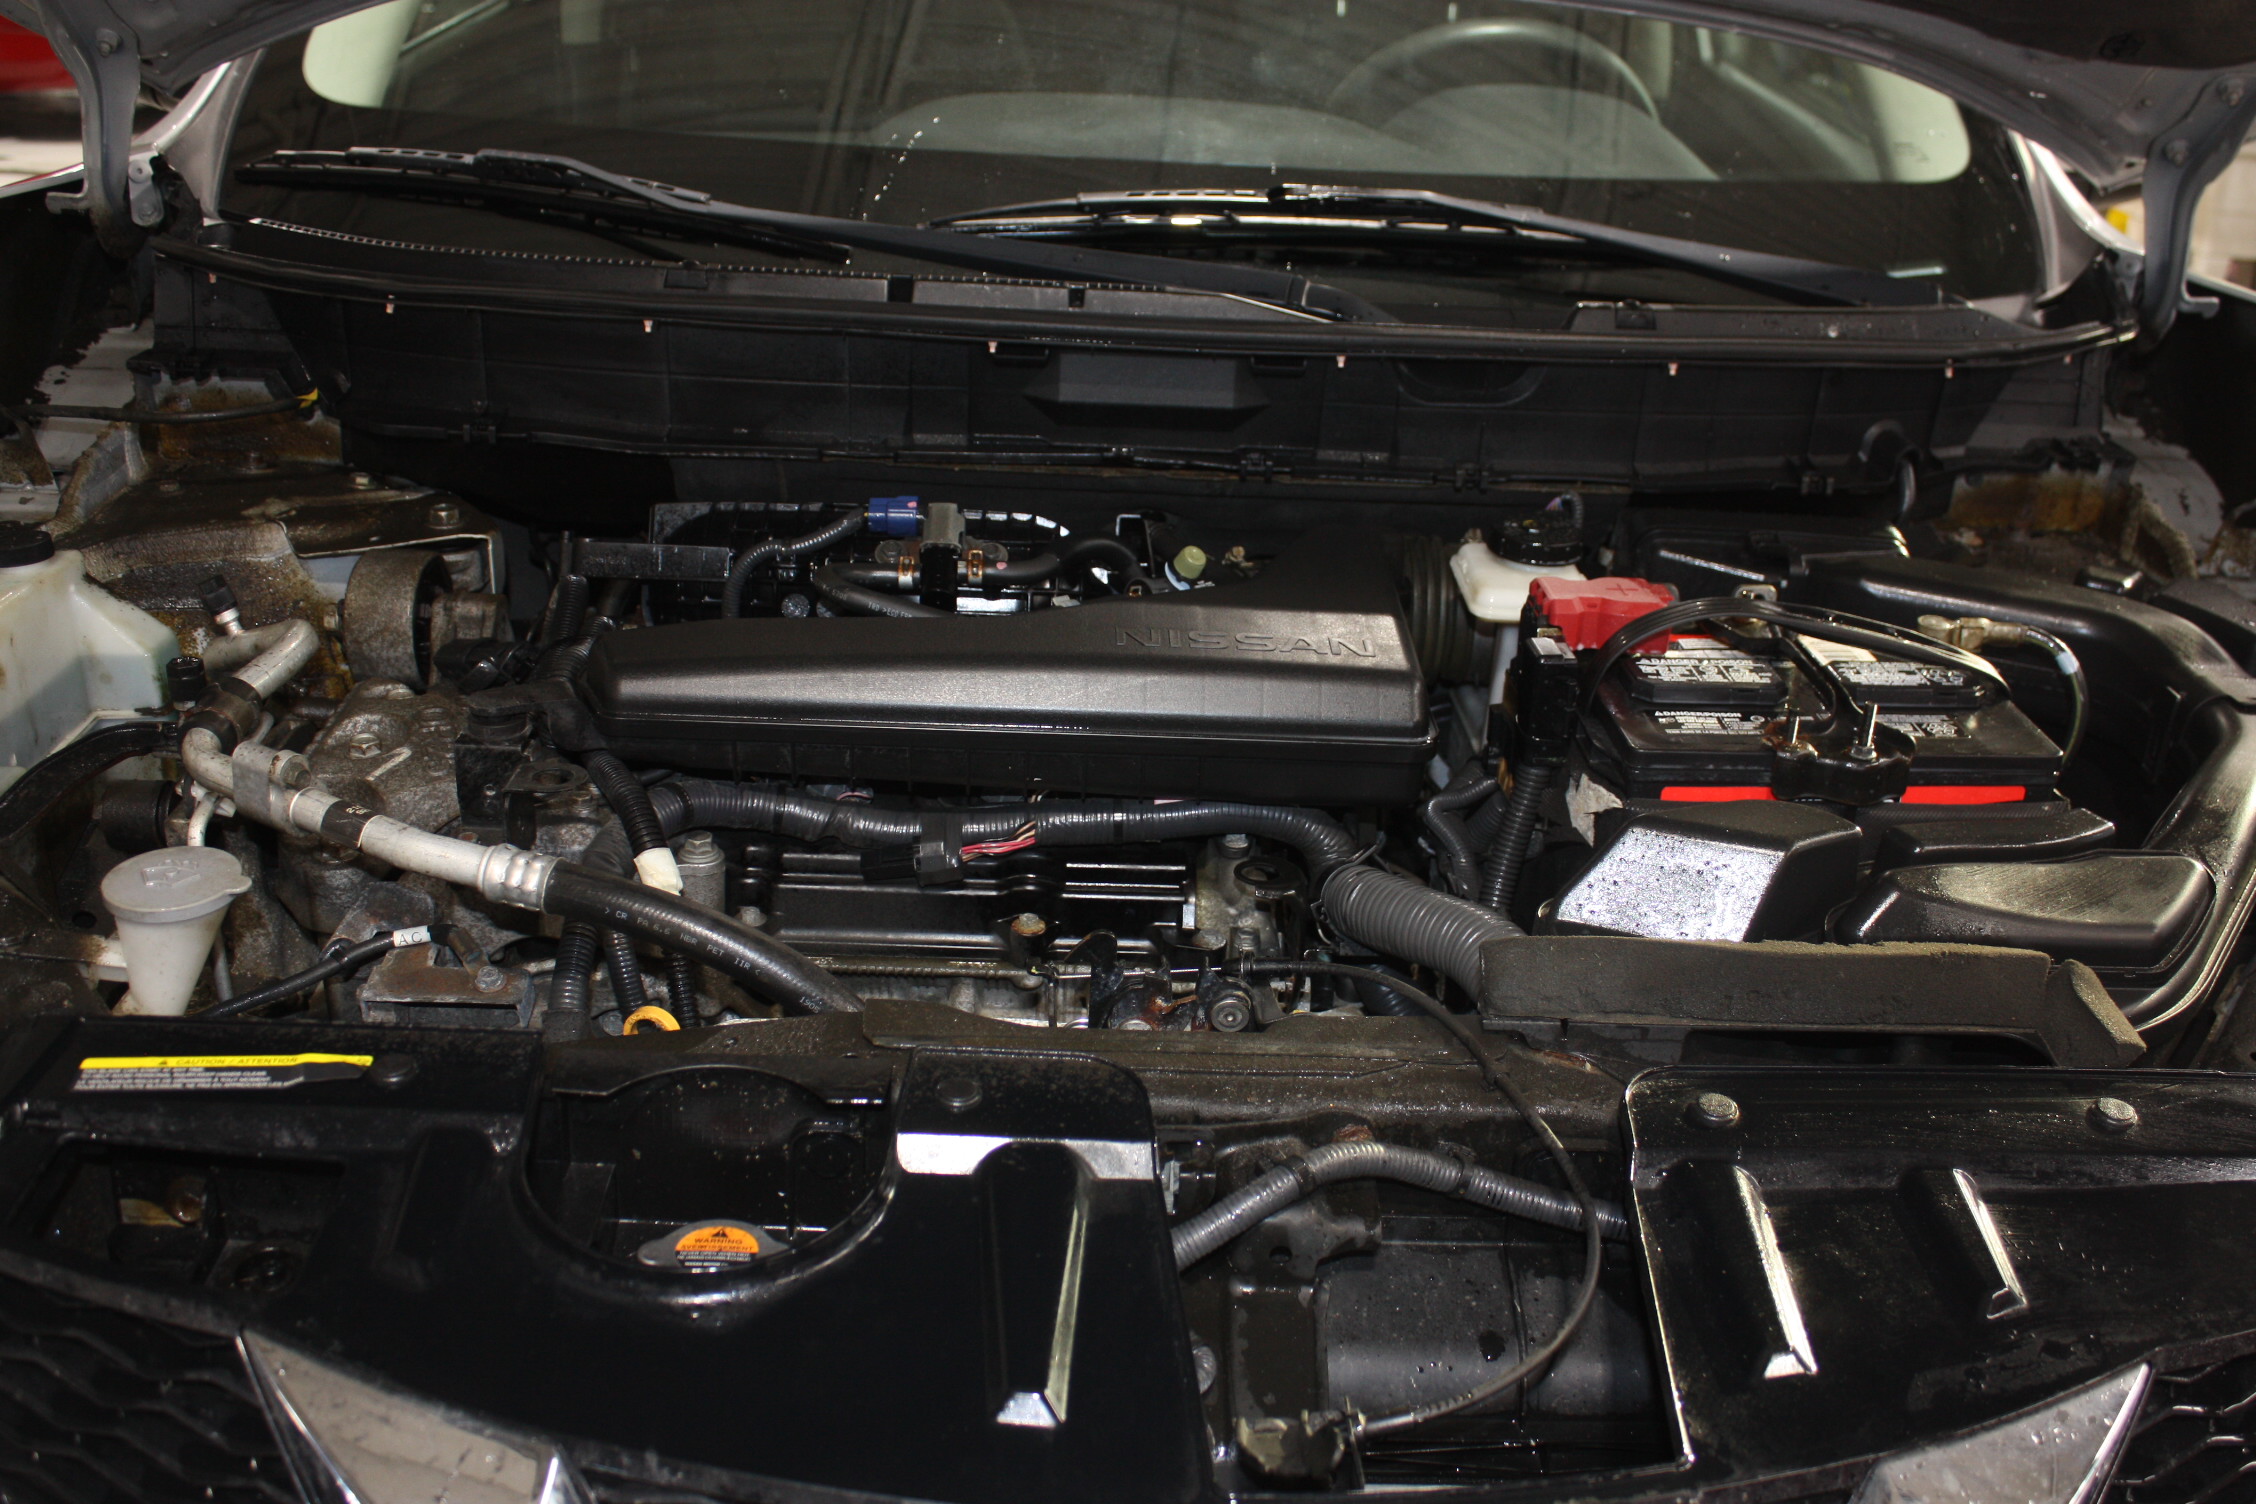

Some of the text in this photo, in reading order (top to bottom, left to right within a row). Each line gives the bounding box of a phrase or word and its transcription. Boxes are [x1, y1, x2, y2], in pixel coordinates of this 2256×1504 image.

[1113, 626, 1377, 658] NISSAN
[1650, 657, 1698, 666] DANGER
[615, 910, 628, 920] CR
[636, 917, 649, 927] PA
[706, 944, 725, 957] PET
[733, 957, 751, 970] IIR
[237, 1057, 298, 1065] ATTENTION
